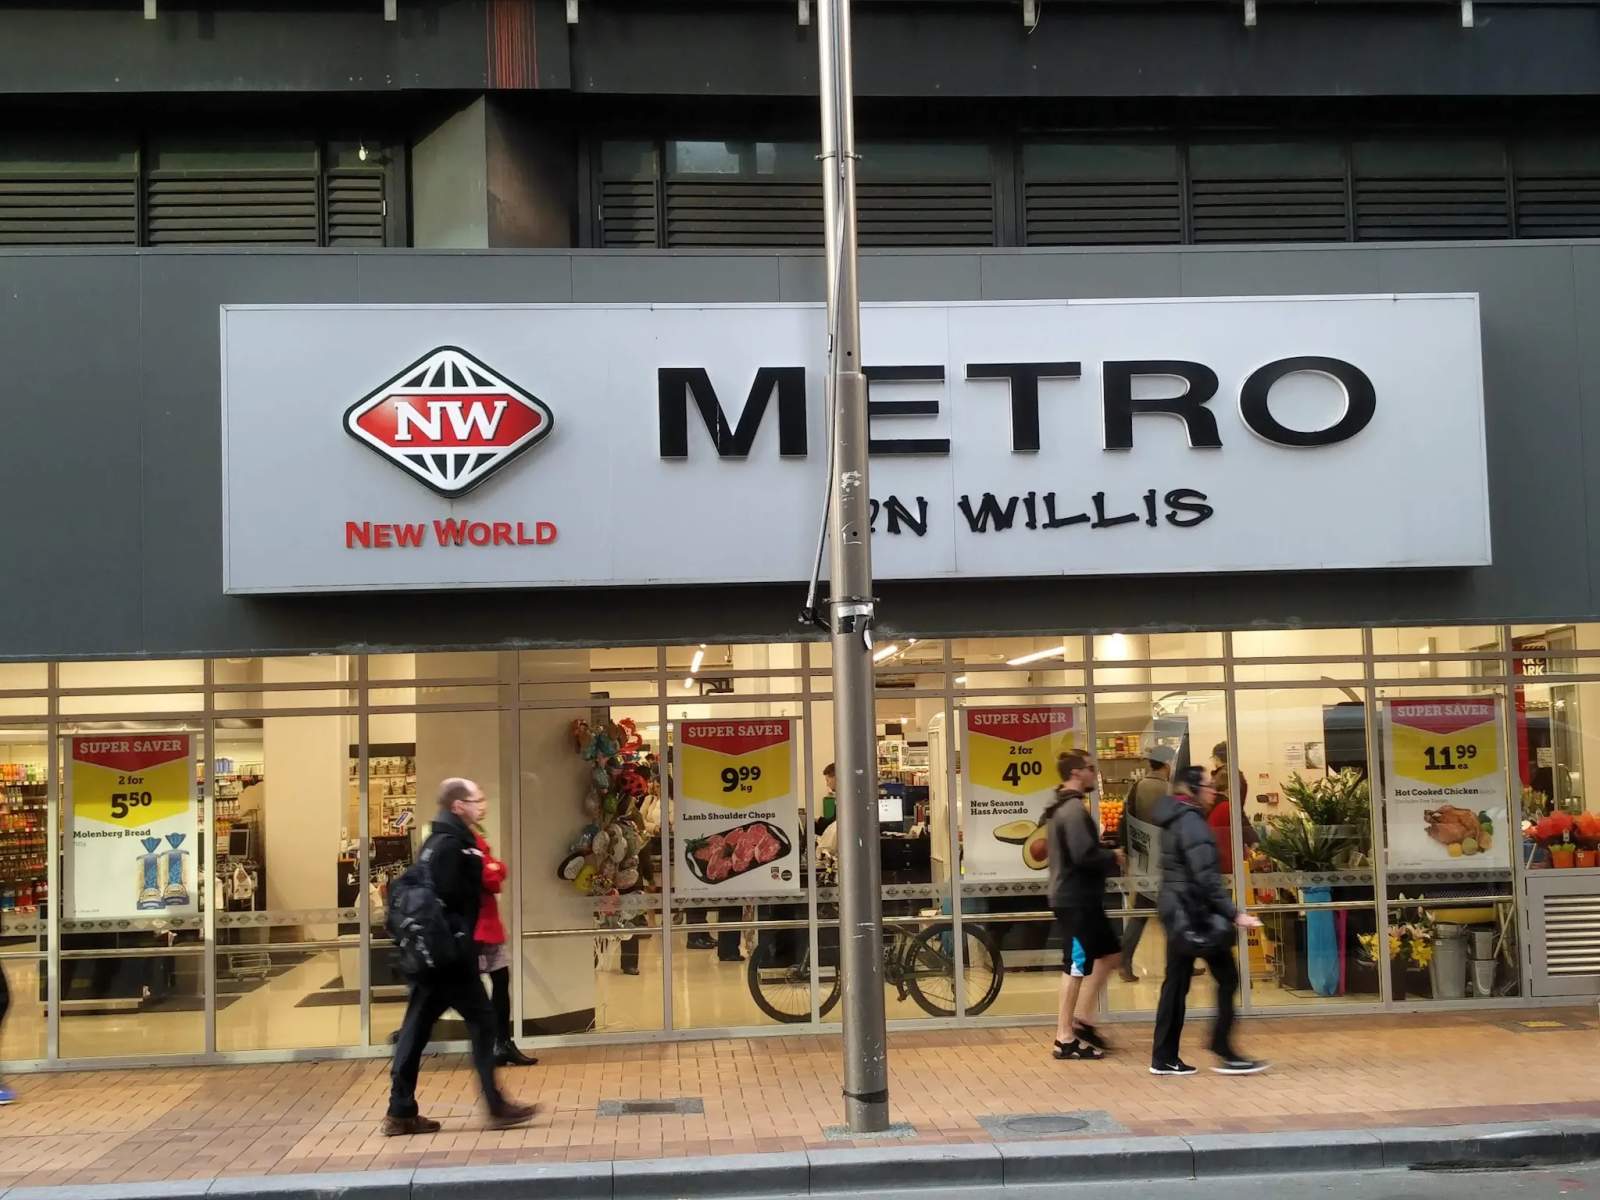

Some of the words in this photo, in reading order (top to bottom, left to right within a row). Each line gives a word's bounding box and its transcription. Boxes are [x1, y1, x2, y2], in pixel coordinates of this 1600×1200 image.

[658, 356, 1377, 460] METRO
[394, 401, 508, 441] NW
[869, 495, 928, 537] N
[957, 488, 1214, 534] WILLIS
[1398, 705, 1442, 717] SUPER
[1444, 703, 1489, 716] SAVER
[974, 713, 1019, 725] SUPER
[1022, 712, 1067, 723] SAVER
[688, 726, 735, 738] SUPER
[738, 725, 783, 736] SAVER
[80, 742, 130, 754] SUPER
[133, 740, 182, 752] SAVER
[1009, 746, 1016, 755] 2
[1018, 745, 1034, 755] for
[118, 776, 125, 785] 2
[127, 775, 145, 785] for
[740, 784, 753, 793] kg
[1395, 789, 1411, 797] Hot
[1411, 788, 1443, 796] Cooked
[1443, 787, 1479, 795] Chicken
[970, 800, 989, 808] New
[990, 799, 1024, 808] Seasons
[682, 813, 706, 821] Lamb
[708, 812, 747, 821] Shoulder
[748, 810, 776, 820] Chops
[970, 808, 990, 816] Hass
[991, 807, 1029, 816] Avocado
[73, 830, 123, 839] Molenberg
[124, 829, 151, 837] Bread
